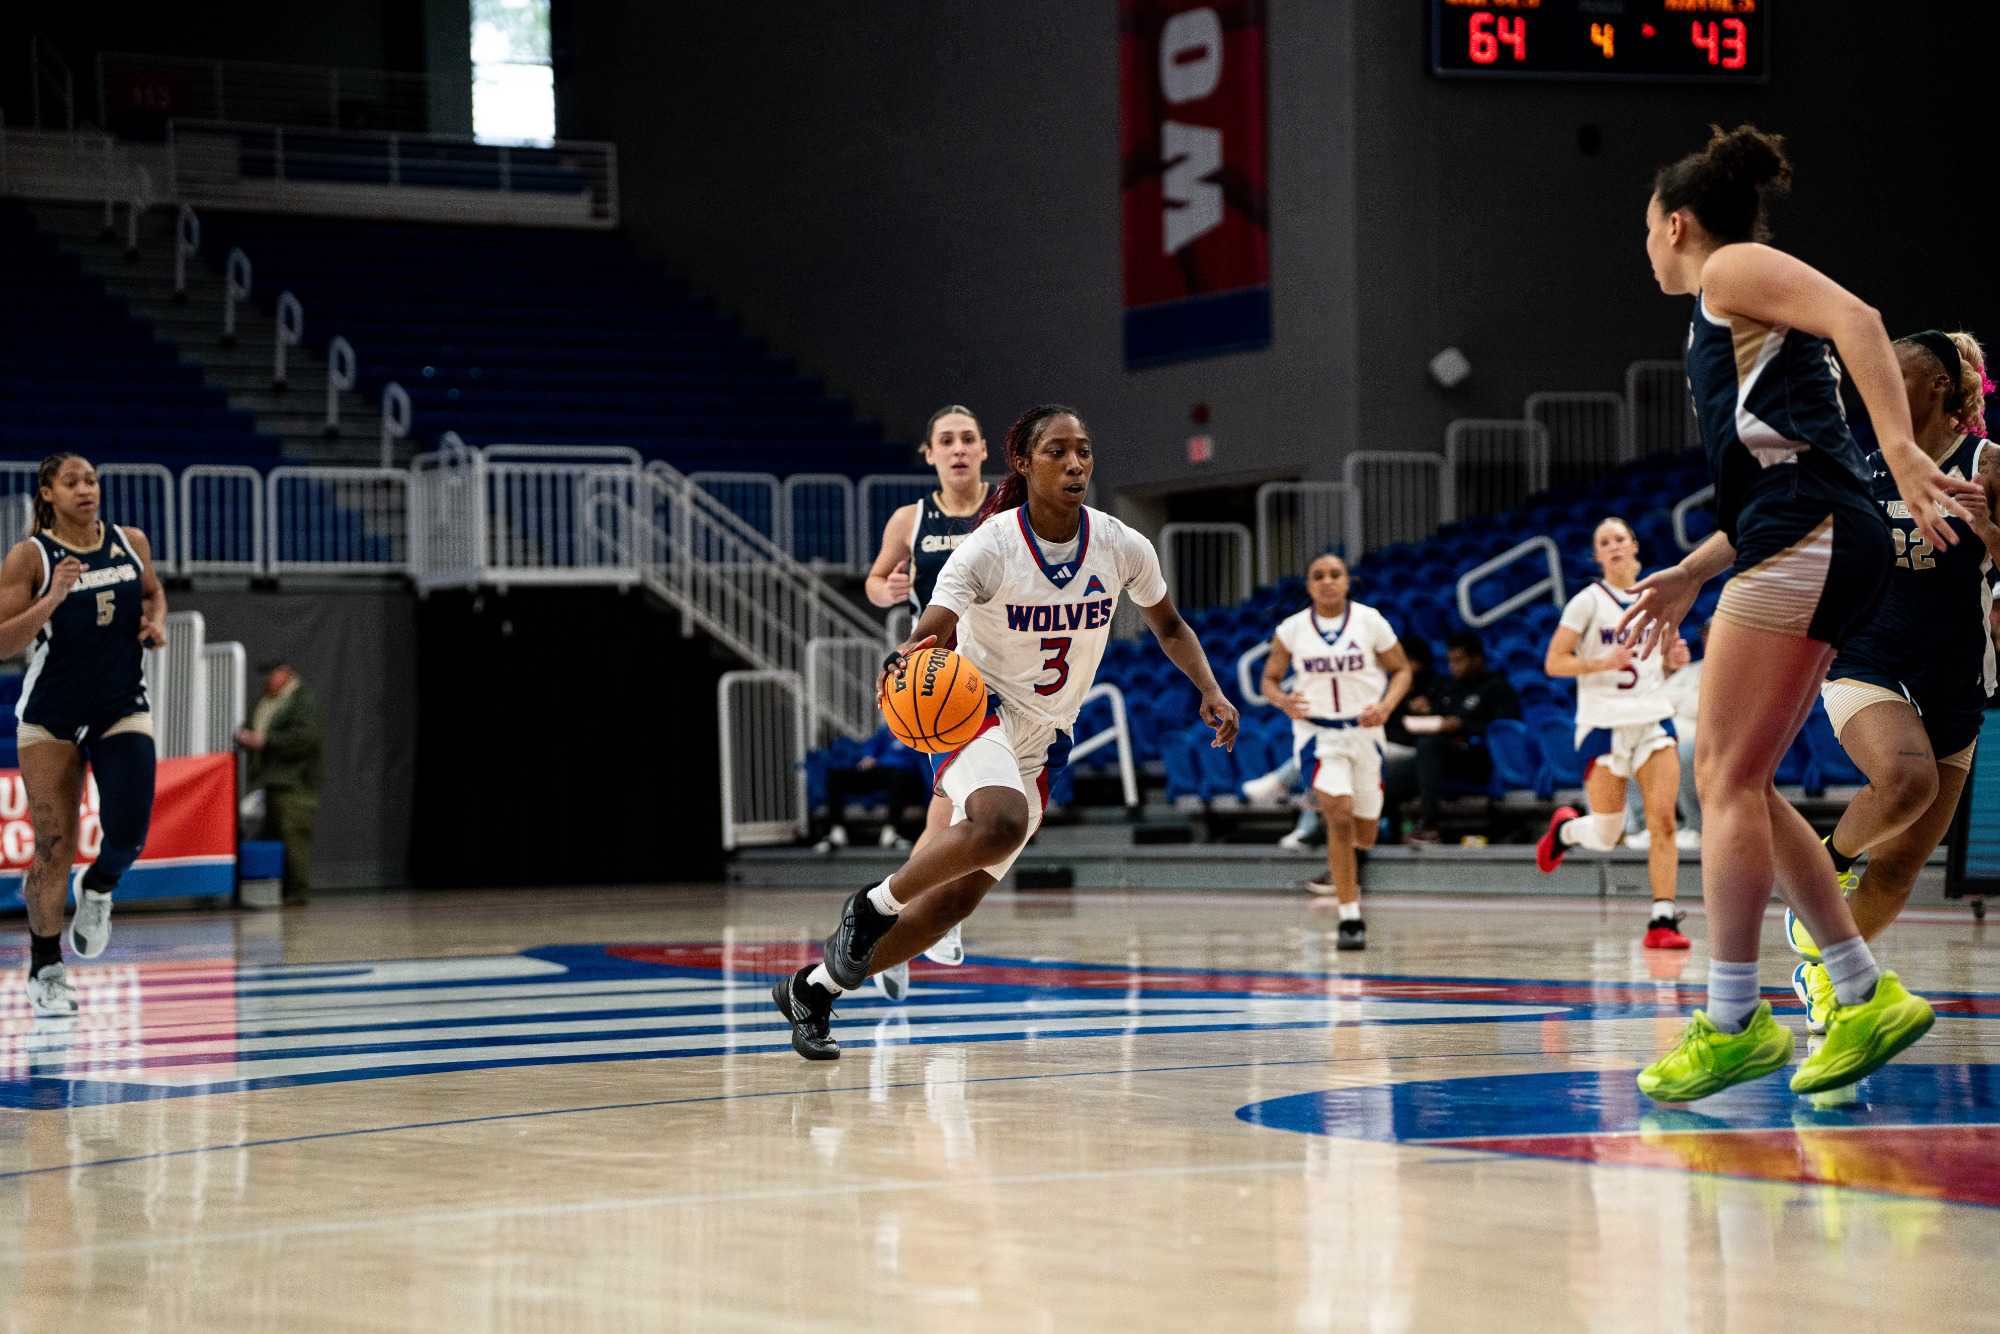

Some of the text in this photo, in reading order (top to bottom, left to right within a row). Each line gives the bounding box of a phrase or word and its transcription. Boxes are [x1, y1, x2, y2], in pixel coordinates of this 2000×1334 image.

[1469, 12, 1526, 64] 64
[1590, 23, 1614, 59] 4
[1691, 18, 1747, 69] 43
[96, 590, 116, 627] 5
[1005, 598, 1113, 632] WOLVES
[1034, 636, 1073, 696] 3
[1303, 654, 1364, 673] WOLVES
[1331, 676, 1341, 712] 1
